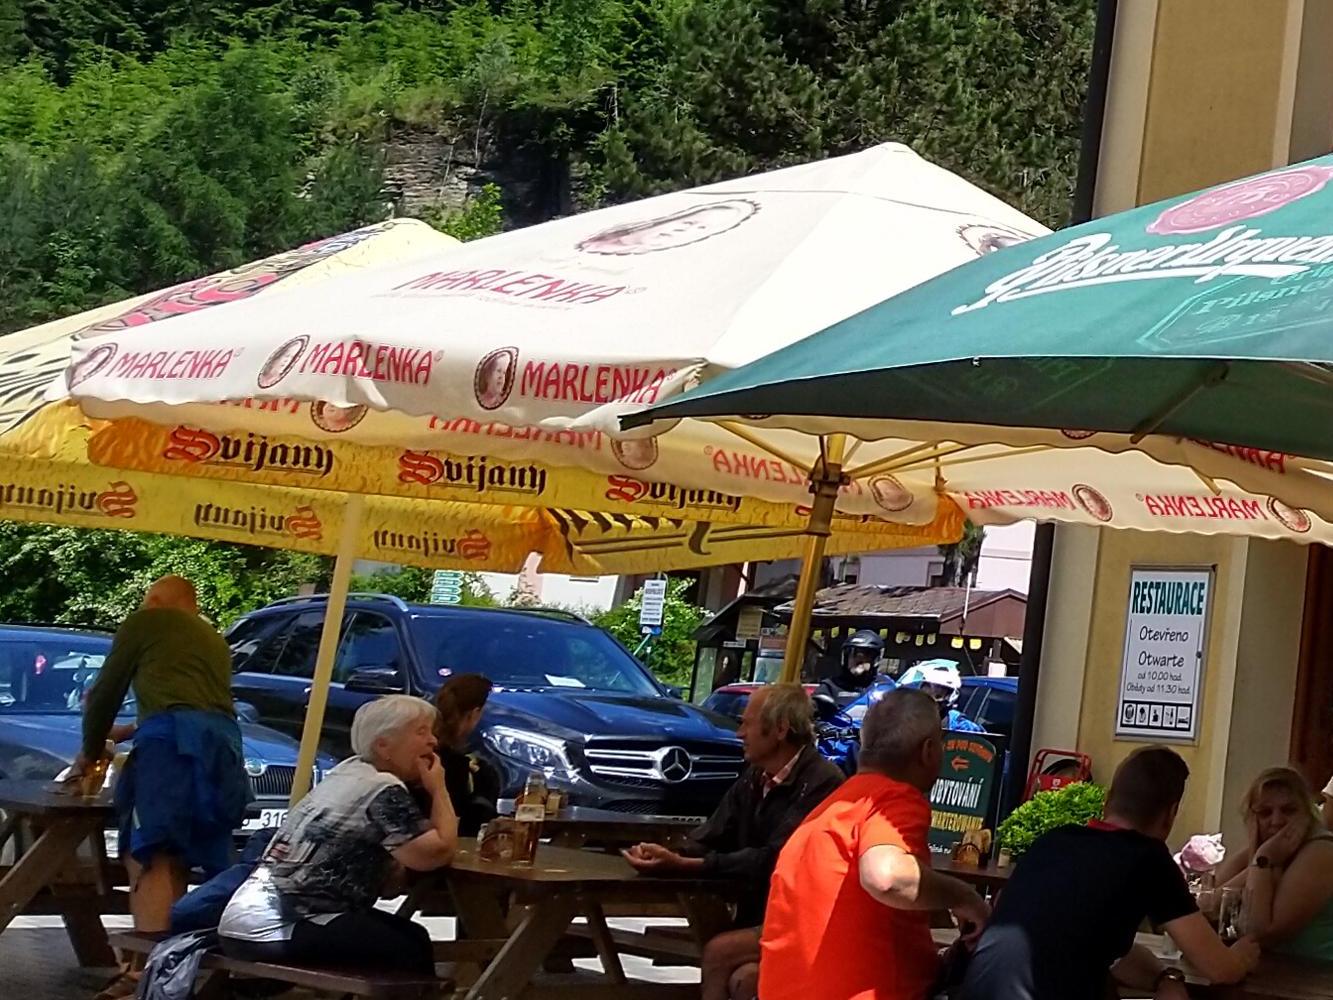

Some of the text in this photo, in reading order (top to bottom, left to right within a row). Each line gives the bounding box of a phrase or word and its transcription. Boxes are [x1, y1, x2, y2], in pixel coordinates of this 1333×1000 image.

[392, 268, 628, 305] MARLENKA
[106, 348, 235, 380] MARLENKA
[300, 340, 435, 386] MARLENKA
[520, 359, 666, 405] MARLENKA
[164, 425, 334, 479] Svijany
[398, 449, 548, 497] Svijany
[1131, 581, 1205, 616] RESTAURACE
[1139, 625, 1189, 642] Otevřeno
[1138, 650, 1185, 668] Otwarte
